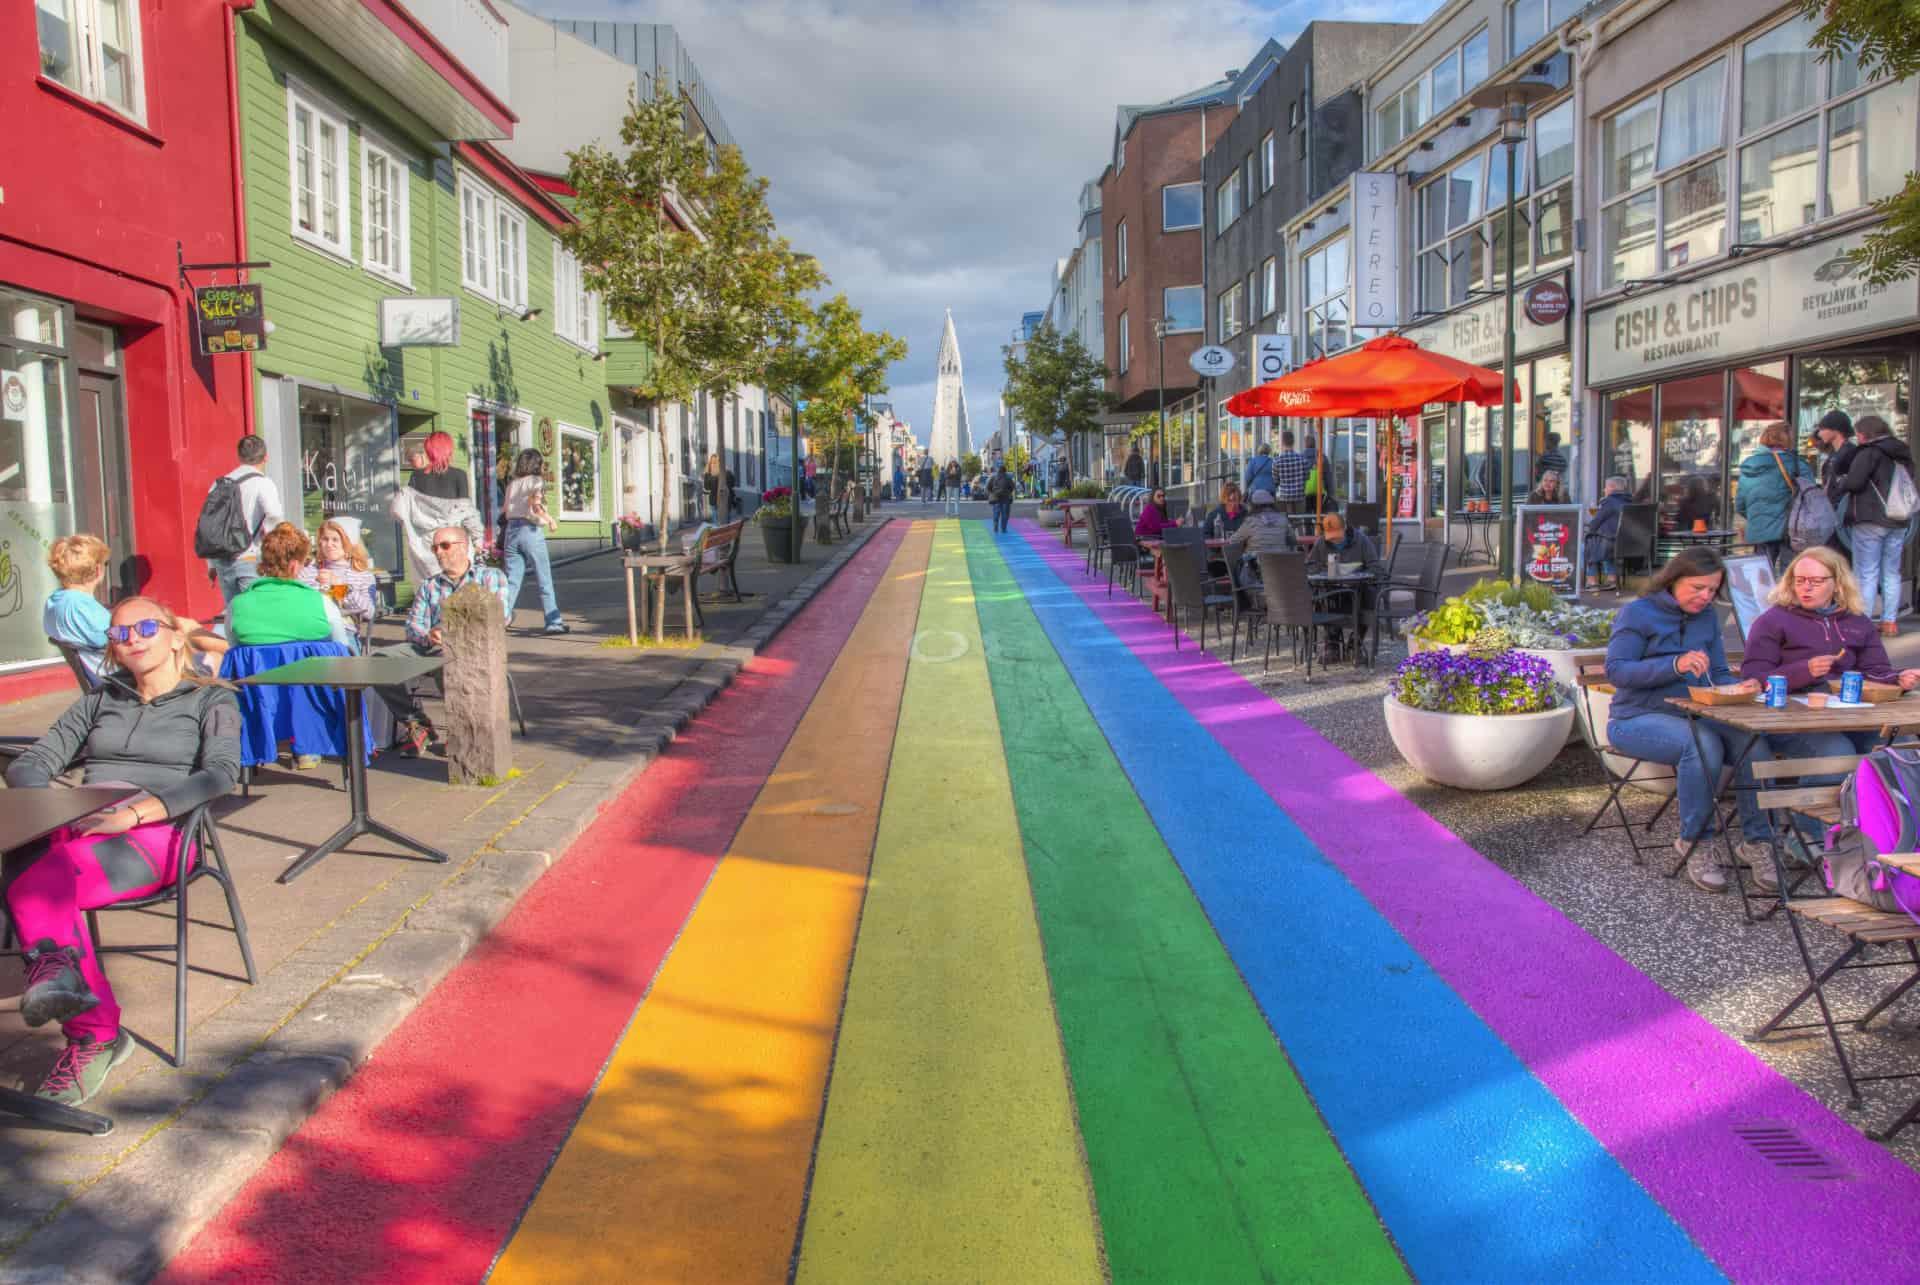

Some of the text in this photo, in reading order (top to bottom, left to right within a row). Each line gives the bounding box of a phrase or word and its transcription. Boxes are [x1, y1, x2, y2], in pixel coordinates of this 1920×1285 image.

[1802, 286, 1857, 311] REYKJAVIK
[1817, 300, 1868, 319] RESTAURANT
[1615, 277, 1757, 350] FISH & CHIPS
[1643, 331, 1721, 362] RESTAURANT
